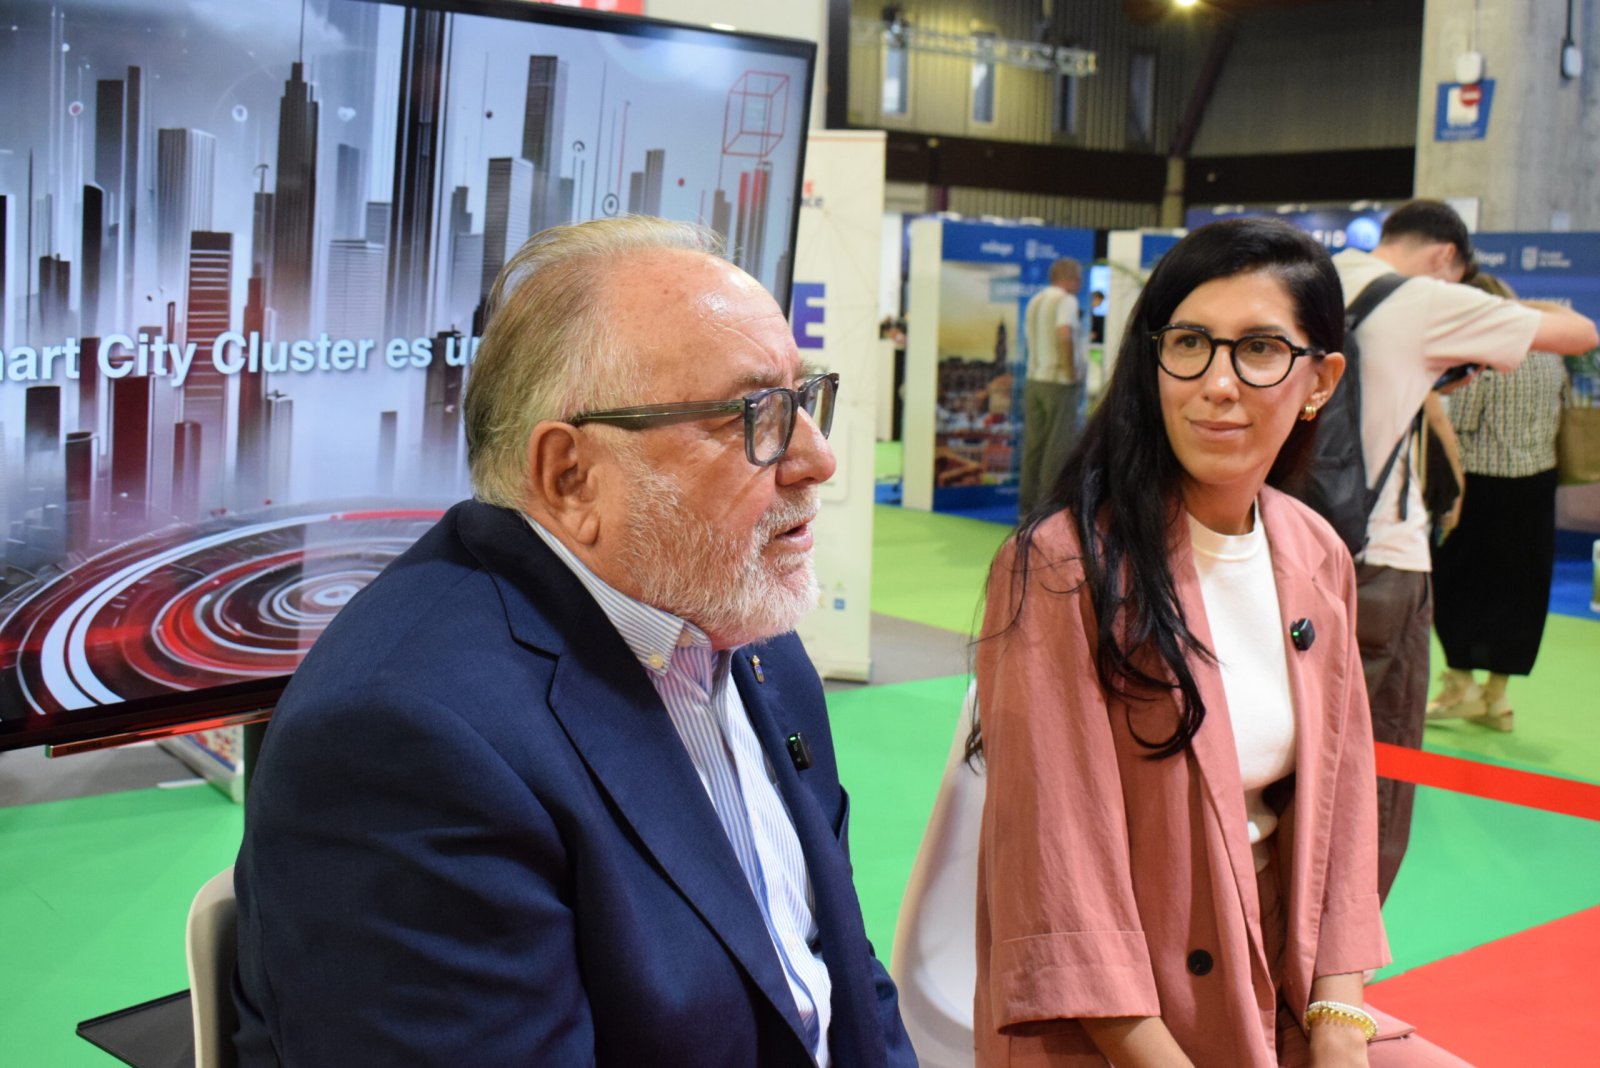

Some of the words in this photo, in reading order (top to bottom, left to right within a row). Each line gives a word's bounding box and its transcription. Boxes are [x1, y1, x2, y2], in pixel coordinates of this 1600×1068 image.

[0, 337, 81, 381] art
[98, 333, 197, 387] City
[213, 331, 375, 375] Cluster
[386, 337, 433, 369] es
